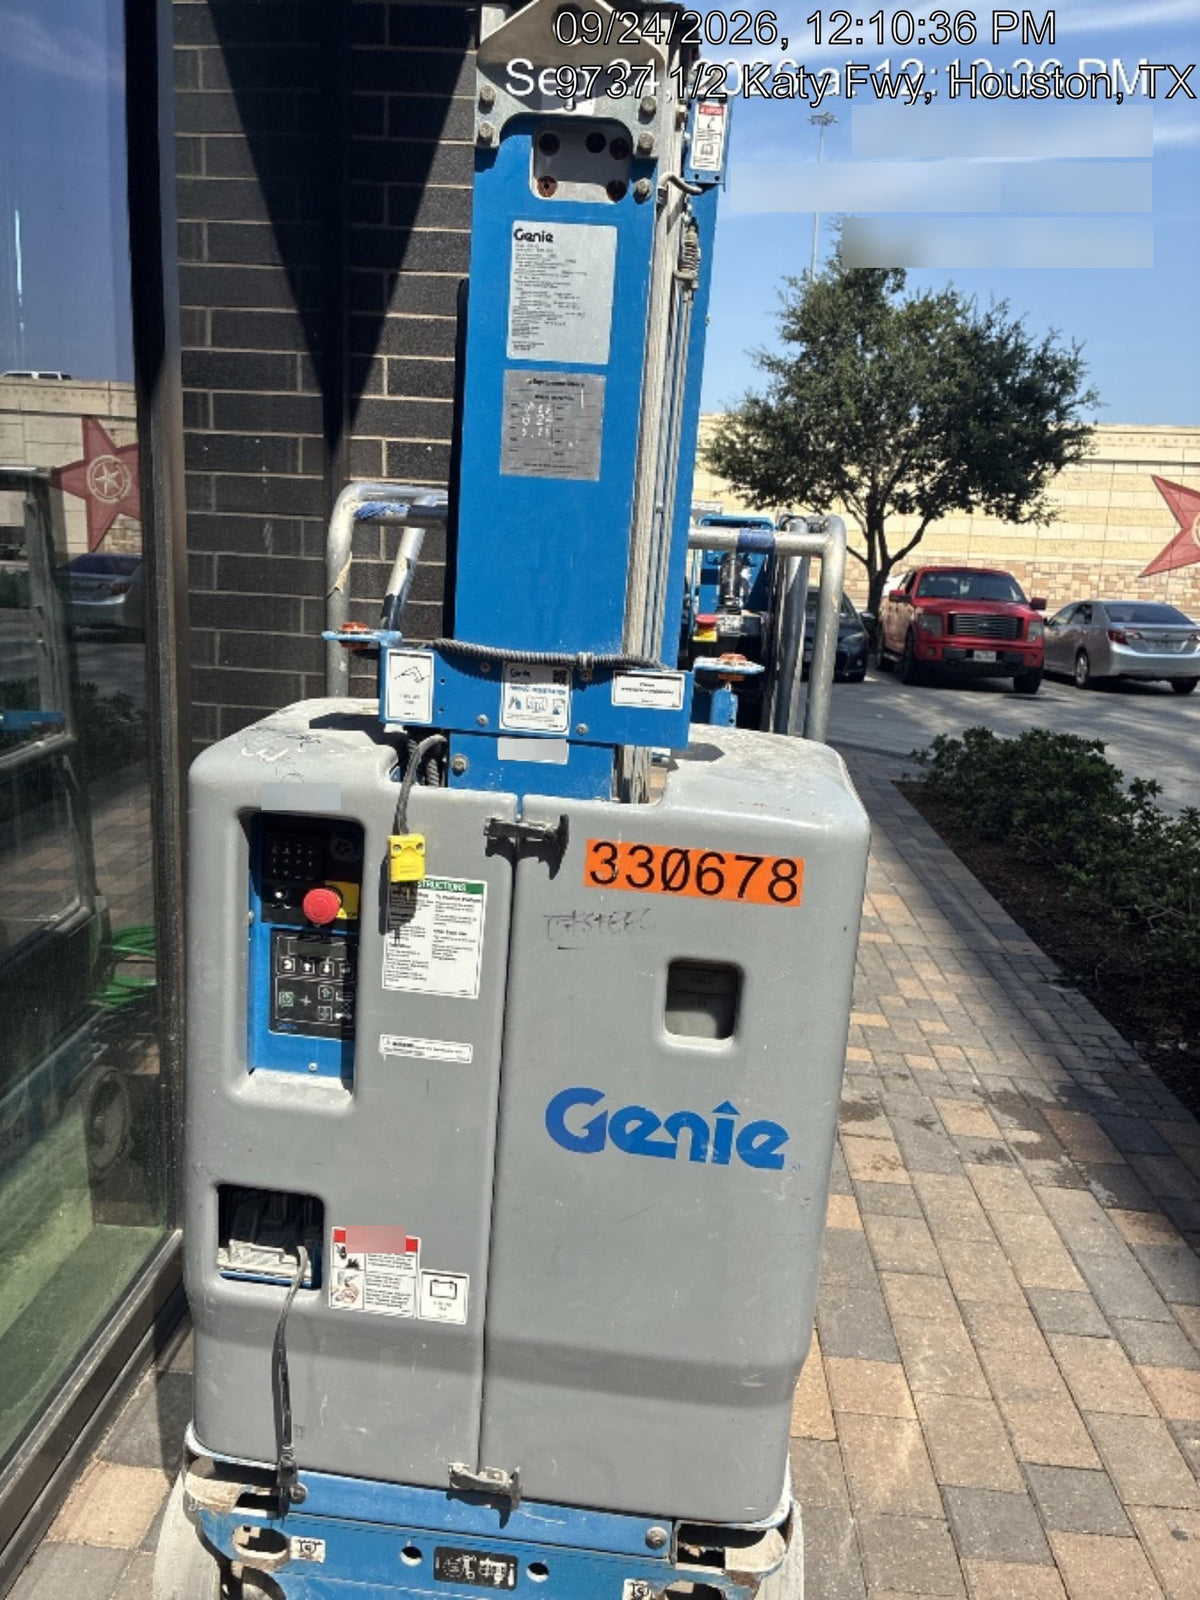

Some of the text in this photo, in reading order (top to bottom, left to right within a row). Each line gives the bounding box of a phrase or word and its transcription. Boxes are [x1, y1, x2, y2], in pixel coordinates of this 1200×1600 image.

[513, 228, 554, 243] Genie
[588, 841, 799, 903] 330678
[545, 1087, 790, 1170] Genie
